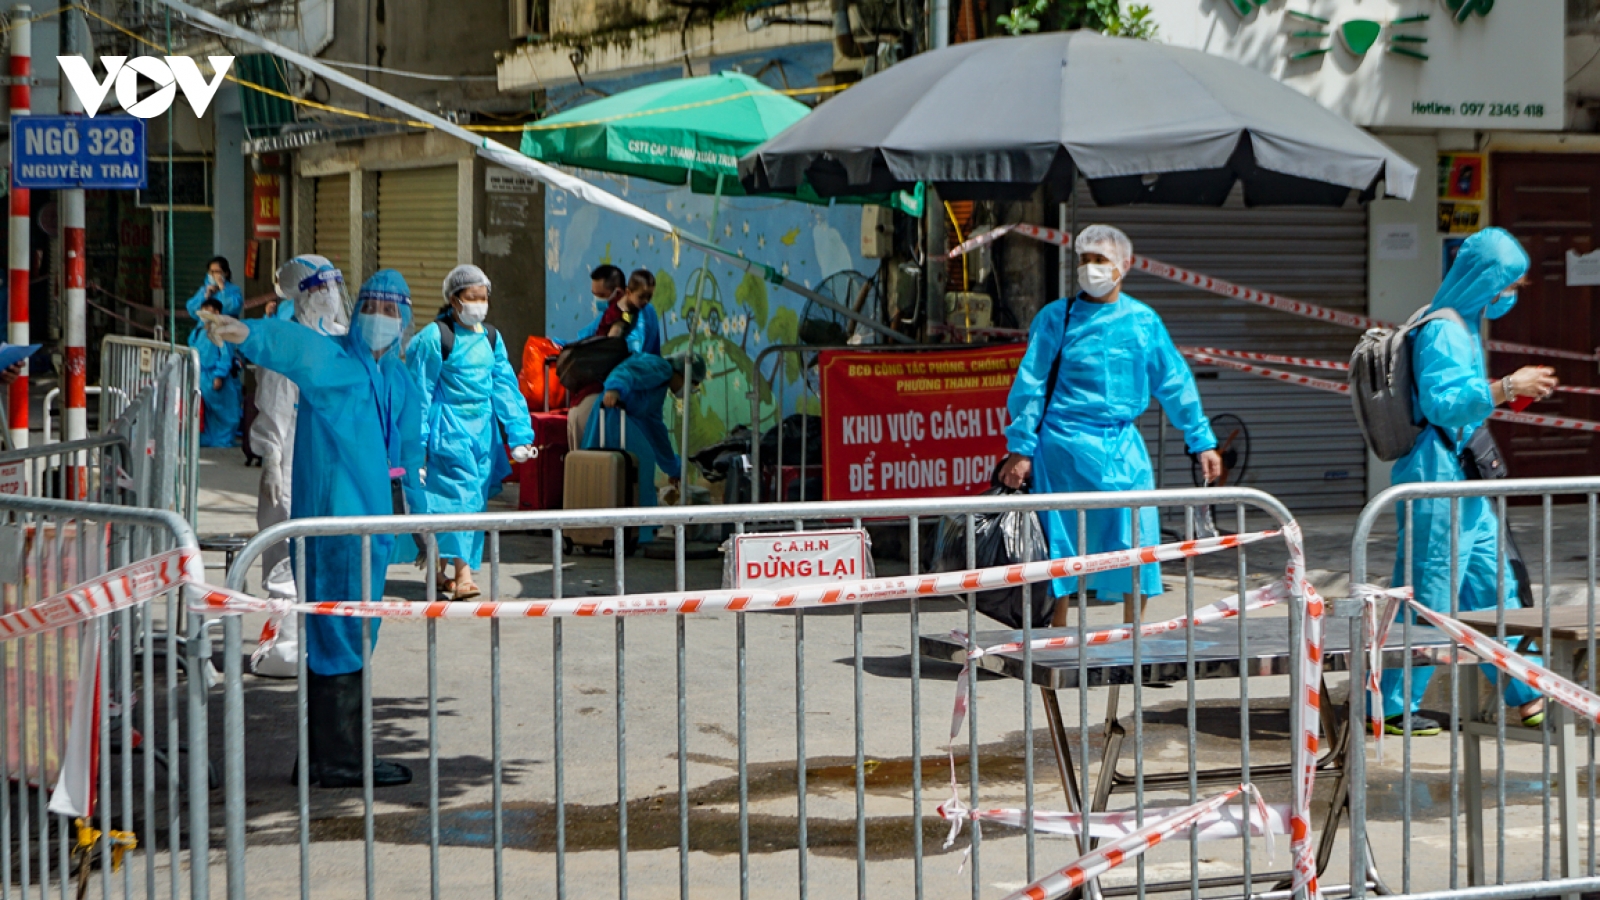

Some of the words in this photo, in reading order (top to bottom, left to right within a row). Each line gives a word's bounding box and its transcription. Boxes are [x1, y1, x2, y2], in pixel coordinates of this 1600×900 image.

[1460, 103, 1484, 115] 097
[1488, 104, 1519, 116] 2345
[1524, 104, 1543, 117] 418
[25, 122, 80, 155] NGÕ
[88, 128, 135, 155] 328
[628, 140, 649, 153] CSTT
[670, 145, 695, 160] THANH
[696, 149, 717, 163] XUÂN
[906, 361, 926, 374] TÁC
[944, 376, 979, 390] THANH
[982, 373, 1011, 387] XUÂN
[842, 414, 883, 445] KHU
[887, 409, 925, 448] VỰC
[930, 404, 981, 440] CÁCH
[986, 407, 1008, 436] LY
[849, 450, 875, 493] ĐỂ
[881, 453, 947, 490] PHÒNG
[953, 454, 996, 490] DỊCH
[773, 540, 829, 552] C.A.H.N
[746, 555, 812, 579] DỪNG
[818, 558, 855, 579] LẠI
